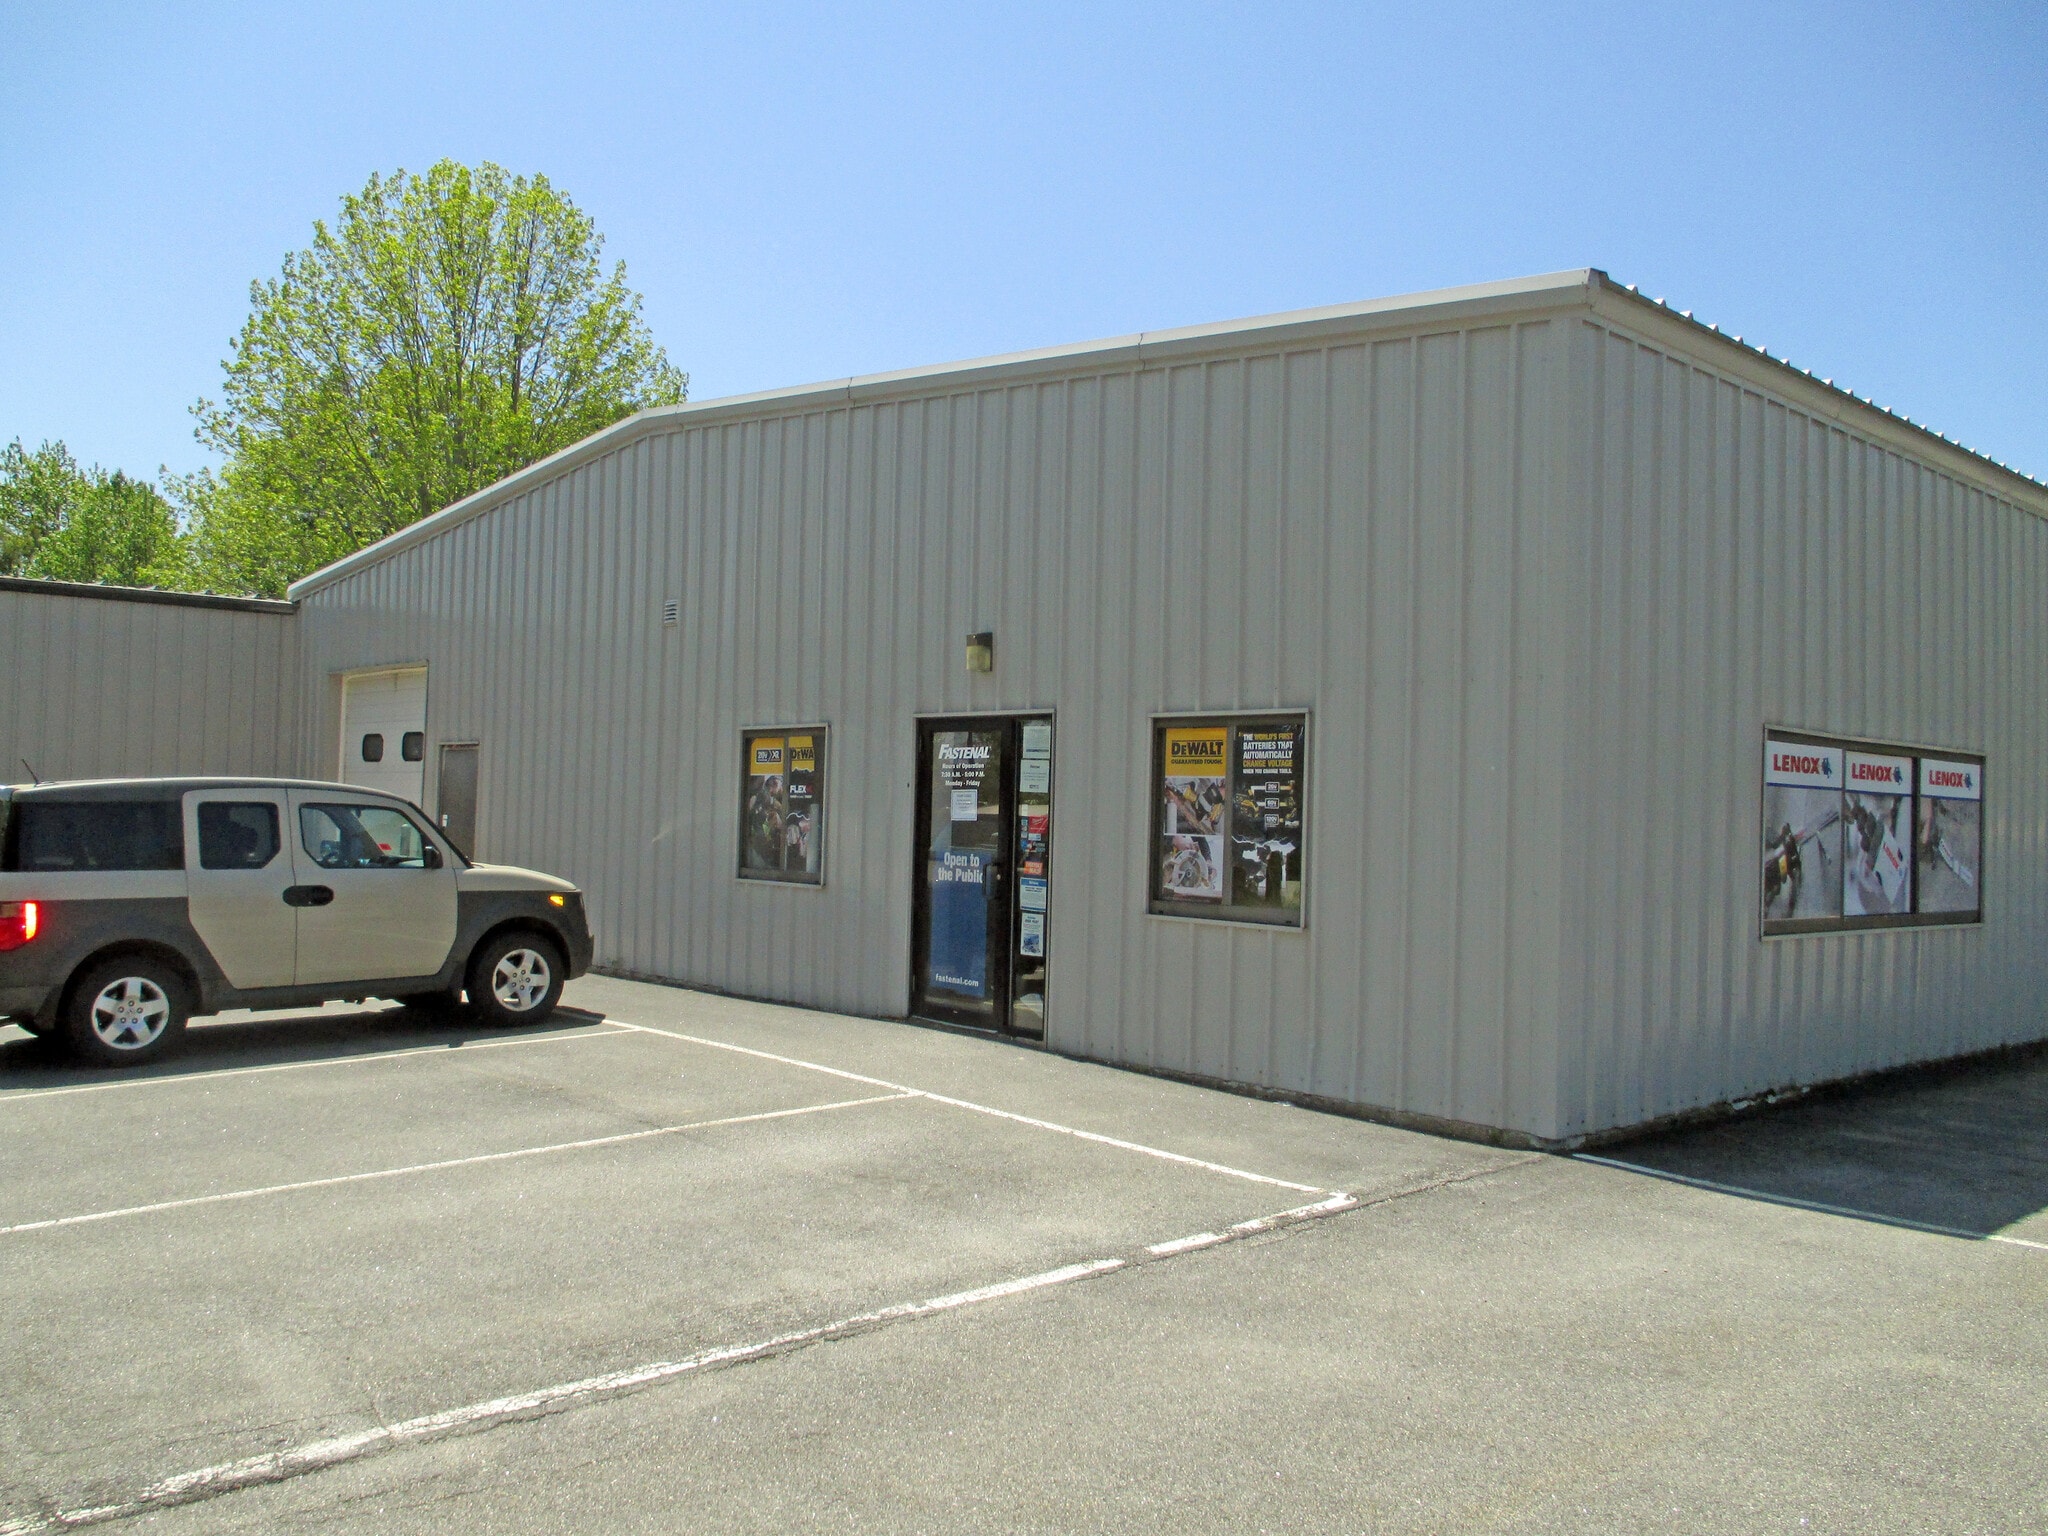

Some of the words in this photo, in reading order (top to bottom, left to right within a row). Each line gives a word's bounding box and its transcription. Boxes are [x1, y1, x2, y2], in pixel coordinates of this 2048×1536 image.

[938, 744, 990, 759] FASTENAL
[1243, 742, 1276, 750] BATTERIES
[1277, 741, 1293, 749] THAT
[1243, 751, 1293, 759] AUTOMATICALLY
[1773, 754, 1820, 775] LENOX
[1851, 763, 1892, 782] LENOX
[1929, 769, 1964, 788] LENOX
[944, 852, 967, 868] Open
[970, 853, 980, 868] to
[938, 867, 953, 882] the
[955, 868, 983, 884] Public
[935, 973, 979, 988] fastenal.com
